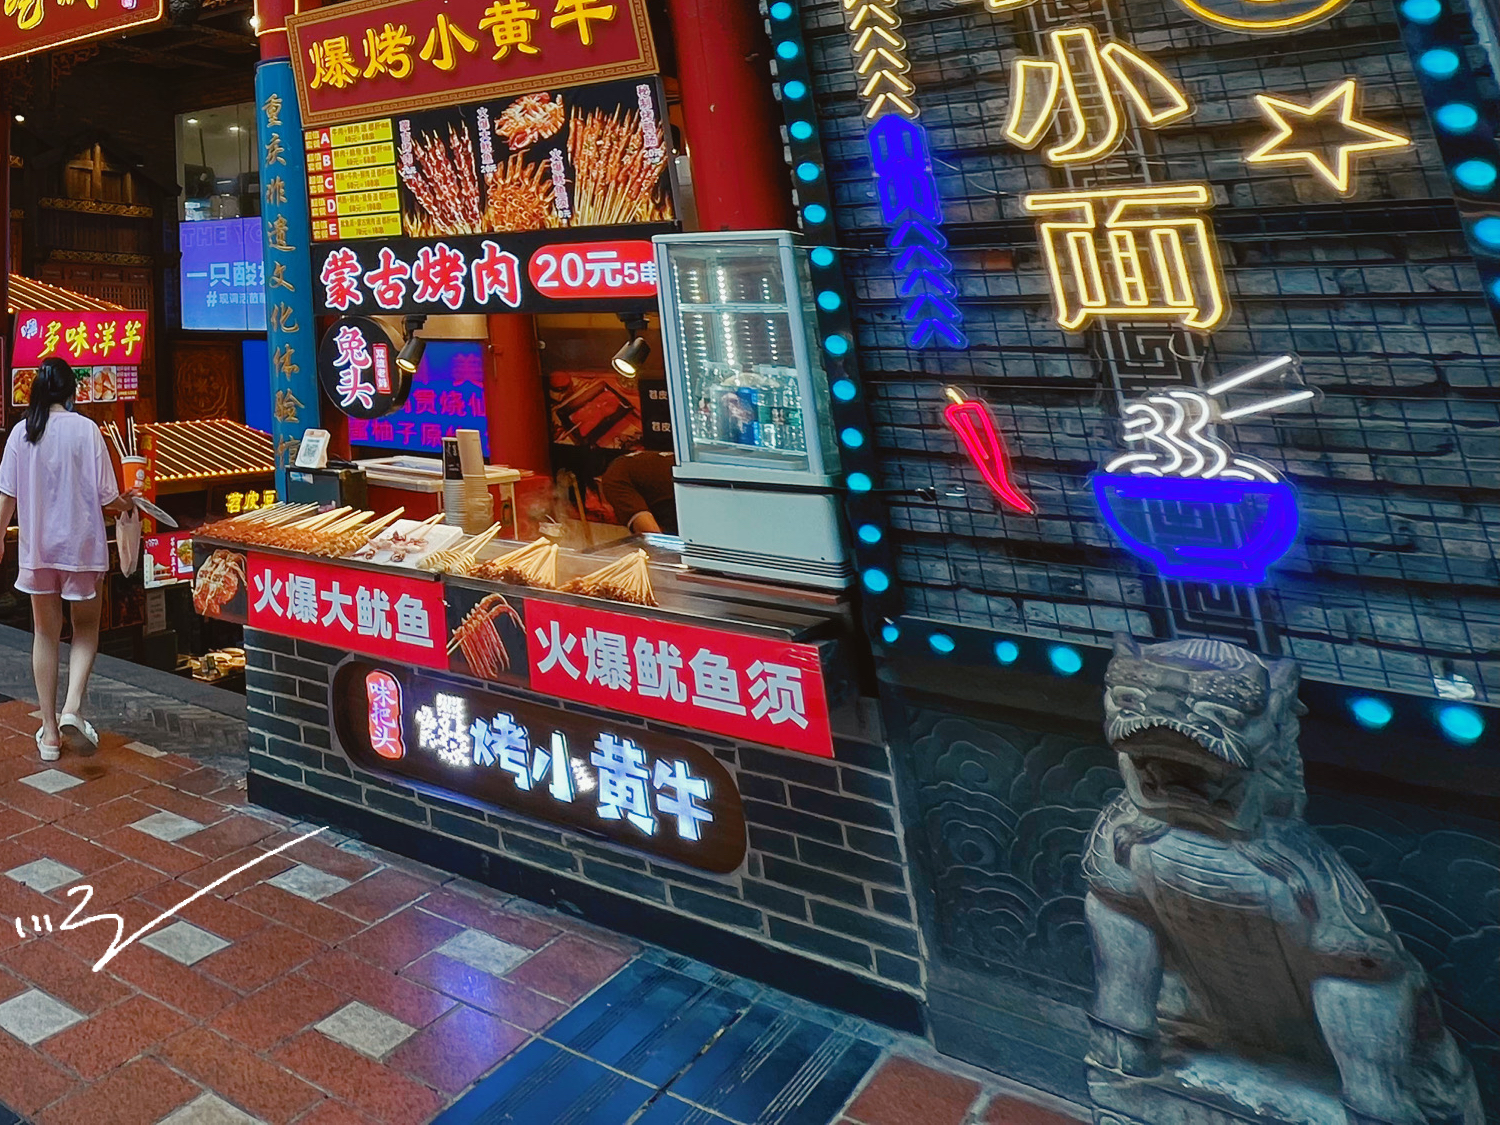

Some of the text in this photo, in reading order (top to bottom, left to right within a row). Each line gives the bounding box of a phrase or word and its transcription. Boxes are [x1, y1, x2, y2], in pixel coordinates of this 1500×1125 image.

[320, 132, 330, 145] A
[322, 154, 331, 167] B
[324, 177, 334, 190] C
[326, 199, 336, 213] D
[181, 225, 227, 247] THE
[328, 223, 338, 236] E
[319, 238, 522, 311] 蒙古烤肉
[37, 320, 142, 358] 多味洋芋
[332, 325, 376, 410] 兔头
[252, 567, 434, 648] 火爆大鱿鱼
[534, 619, 809, 732] 火爆鱿鱼须
[369, 676, 397, 755] 味把头
[415, 693, 715, 841] 爆烤小黄牛
